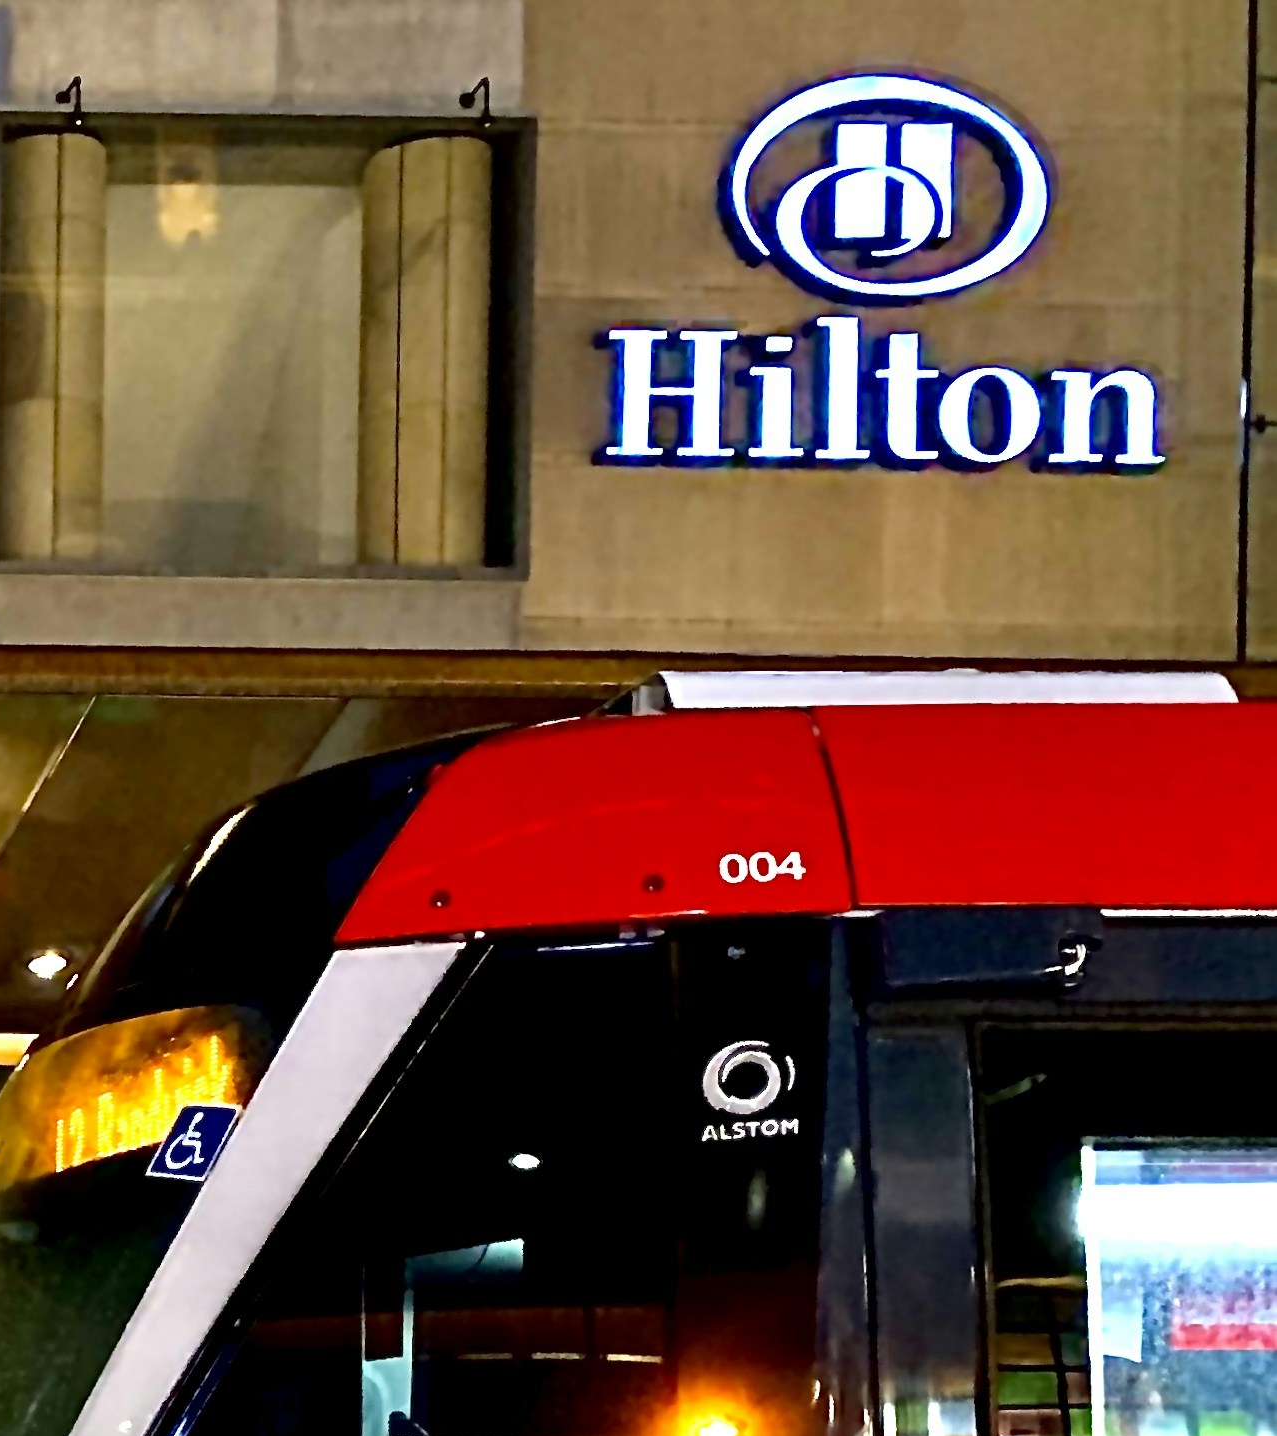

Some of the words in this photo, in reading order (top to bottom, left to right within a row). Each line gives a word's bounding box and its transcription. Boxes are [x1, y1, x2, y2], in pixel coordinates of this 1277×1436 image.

[605, 316, 1167, 465] Hilton
[718, 851, 807, 884] 004
[701, 1118, 800, 1142] ALSTOM
